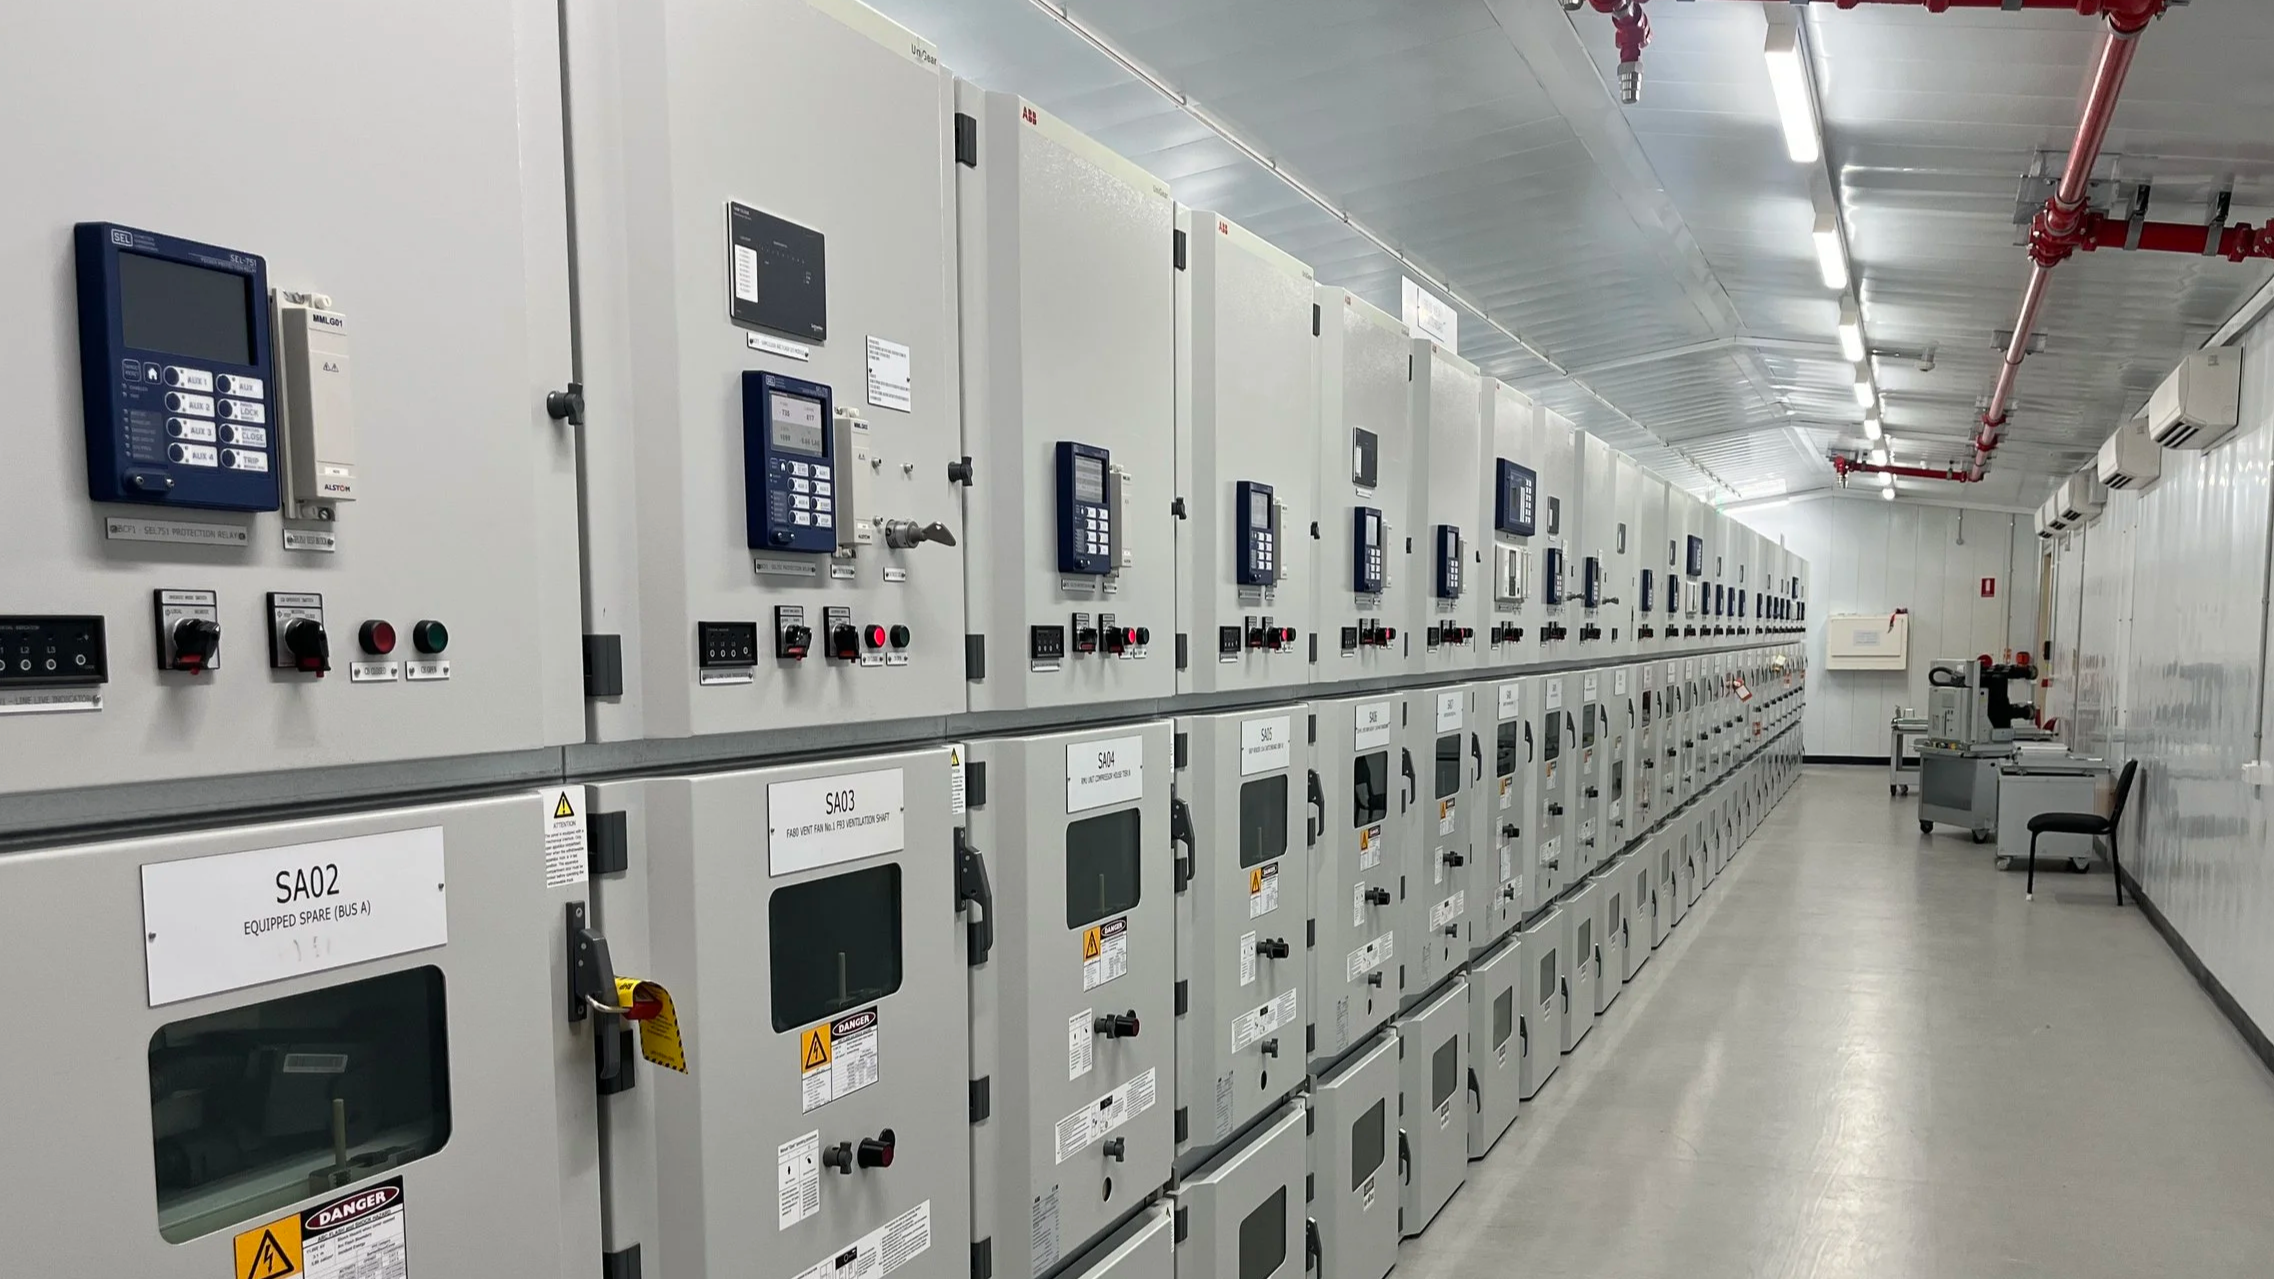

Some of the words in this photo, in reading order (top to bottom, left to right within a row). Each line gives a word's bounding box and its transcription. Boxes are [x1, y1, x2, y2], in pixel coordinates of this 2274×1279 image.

[1022, 106, 1037, 125] ABB
[1218, 221, 1228, 234] ABB
[114, 232, 131, 244] SEL
[230, 254, 257, 267] SEL-751
[312, 314, 343, 328] MMLG01
[187, 376, 202, 385] AUX
[204, 377, 207, 386] 1
[239, 383, 253, 391] AUX
[189, 401, 204, 410] AUX
[205, 403, 210, 411] 2
[240, 406, 259, 416] LOCK
[190, 427, 206, 436] AUX
[241, 431, 264, 442] CLOSE
[192, 452, 208, 460] AUX
[243, 456, 259, 464] TRIP
[325, 484, 350, 492] ALSTOM
[144, 526, 170, 535] SEL751
[172, 527, 215, 538] PROTECTION
[217, 530, 237, 539] RELAY
[371, 667, 386, 675] CLOSED
[1098, 750, 1115, 769] SA04
[826, 790, 855, 814] SA03
[553, 820, 576, 829] ATTENTION
[800, 825, 813, 836] VENT
[814, 824, 824, 833] FAN
[825, 822, 835, 832] No.1
[846, 814, 874, 828] VENTILATION
[876, 812, 890, 823] SHAFT
[276, 864, 340, 903] SA02
[244, 914, 296, 936] EQUIPPED
[299, 907, 331, 925] SPARE
[334, 902, 358, 922] (BUS
[361, 900, 371, 915] A)
[1104, 922, 1123, 934] DANGER
[838, 1014, 870, 1033] DANGER
[319, 1191, 386, 1226] DANGER
